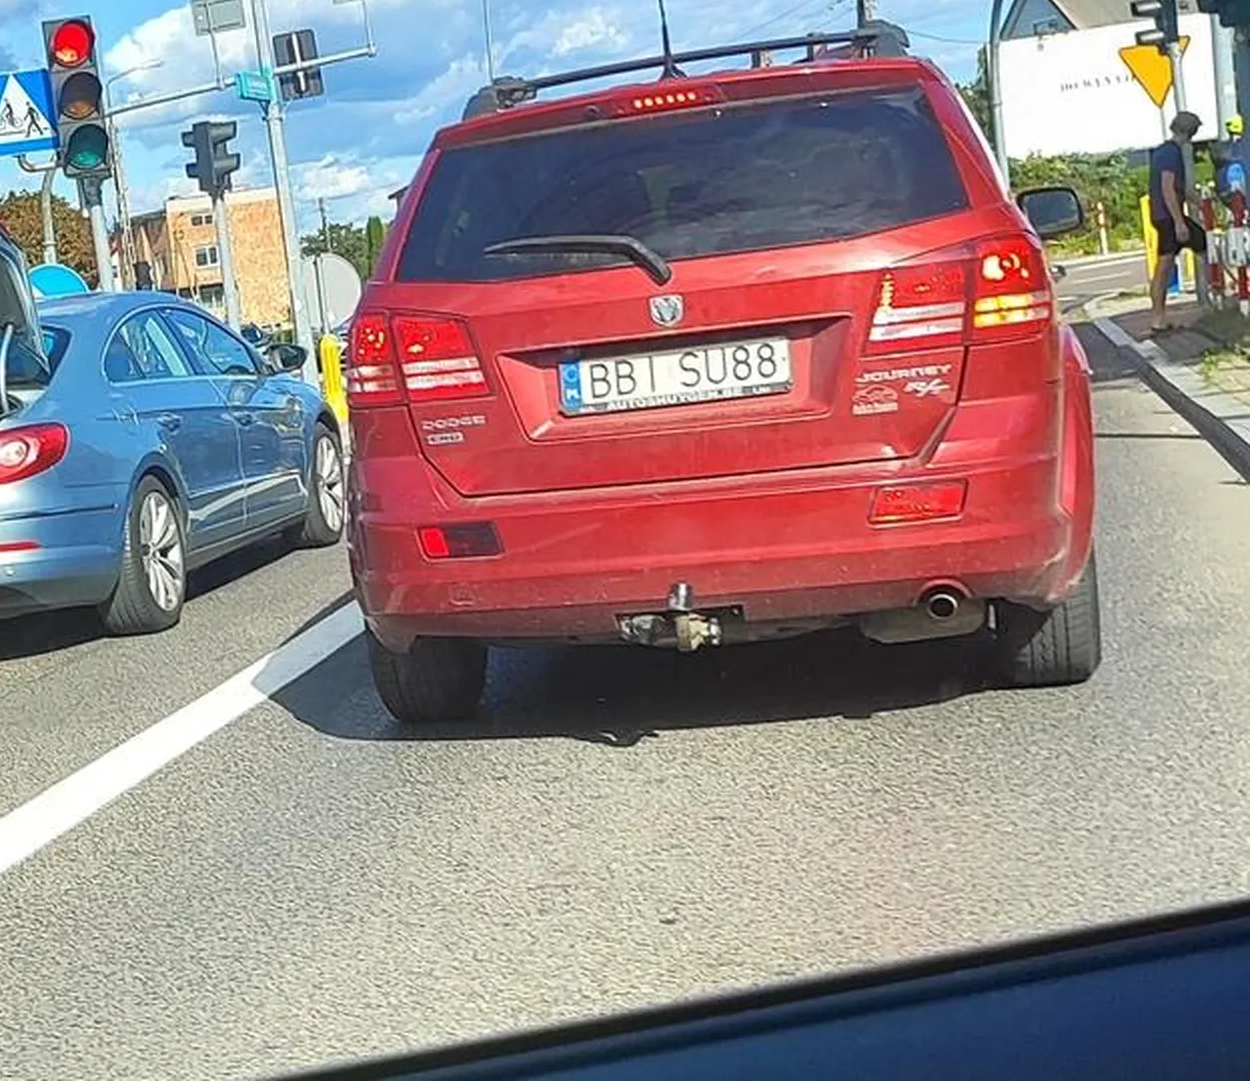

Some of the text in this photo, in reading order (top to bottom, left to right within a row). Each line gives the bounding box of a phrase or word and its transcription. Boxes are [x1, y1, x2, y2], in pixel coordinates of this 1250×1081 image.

[590, 343, 777, 399] BBI SU88
[854, 364, 952, 384] JOURNEY
[421, 415, 486, 430] DODGE
